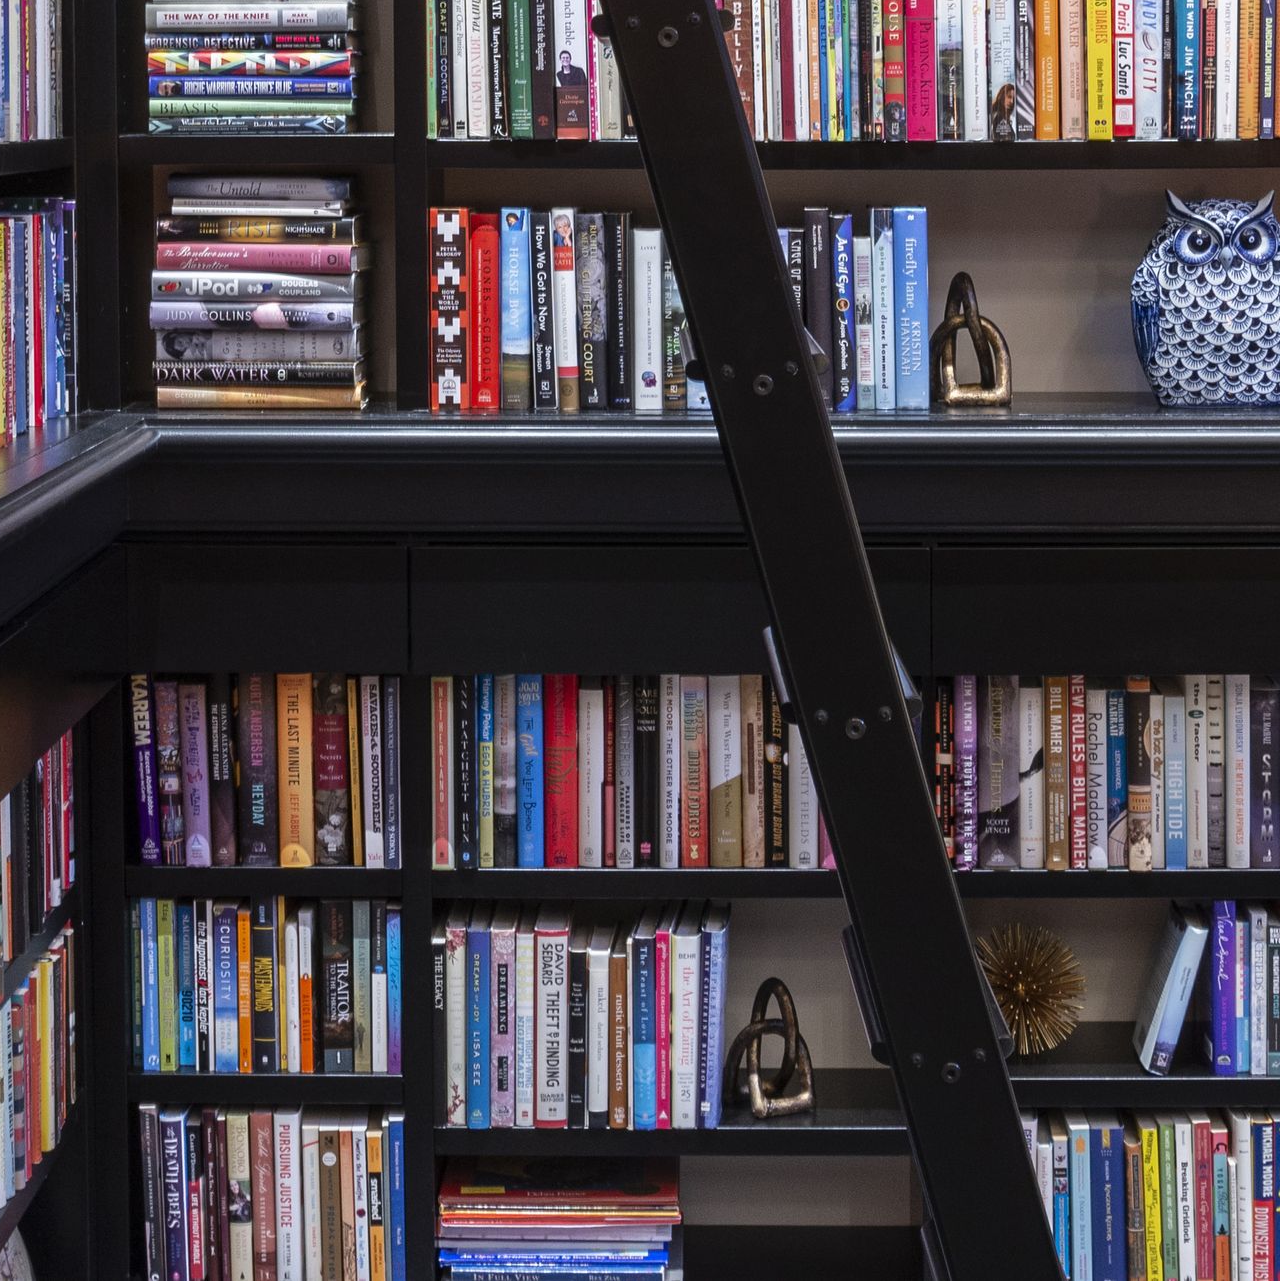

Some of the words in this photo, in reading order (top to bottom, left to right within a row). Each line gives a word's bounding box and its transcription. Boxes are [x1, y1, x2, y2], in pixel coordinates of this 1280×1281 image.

[1118, 1, 1130, 32] Paris
[564, 21, 572, 46] table
[1118, 41, 1128, 60] Luc
[1118, 64, 1128, 96] Sante
[220, 182, 261, 196] Untold
[536, 226, 545, 253] How
[536, 255, 546, 269] We
[186, 279, 238, 296] JPod
[282, 280, 319, 288] DOUGLAS
[537, 271, 546, 291] Got
[538, 293, 546, 303] to
[165, 311, 194, 322] JUDY
[200, 311, 252, 322] COLLINS
[538, 305, 548, 331] Now
[156, 368, 203, 381] DARK
[211, 368, 269, 381] WATER
[131, 674, 151, 746] KAREEM
[542, 942, 553, 987] SEDARIS
[553, 942, 565, 986] DAVID
